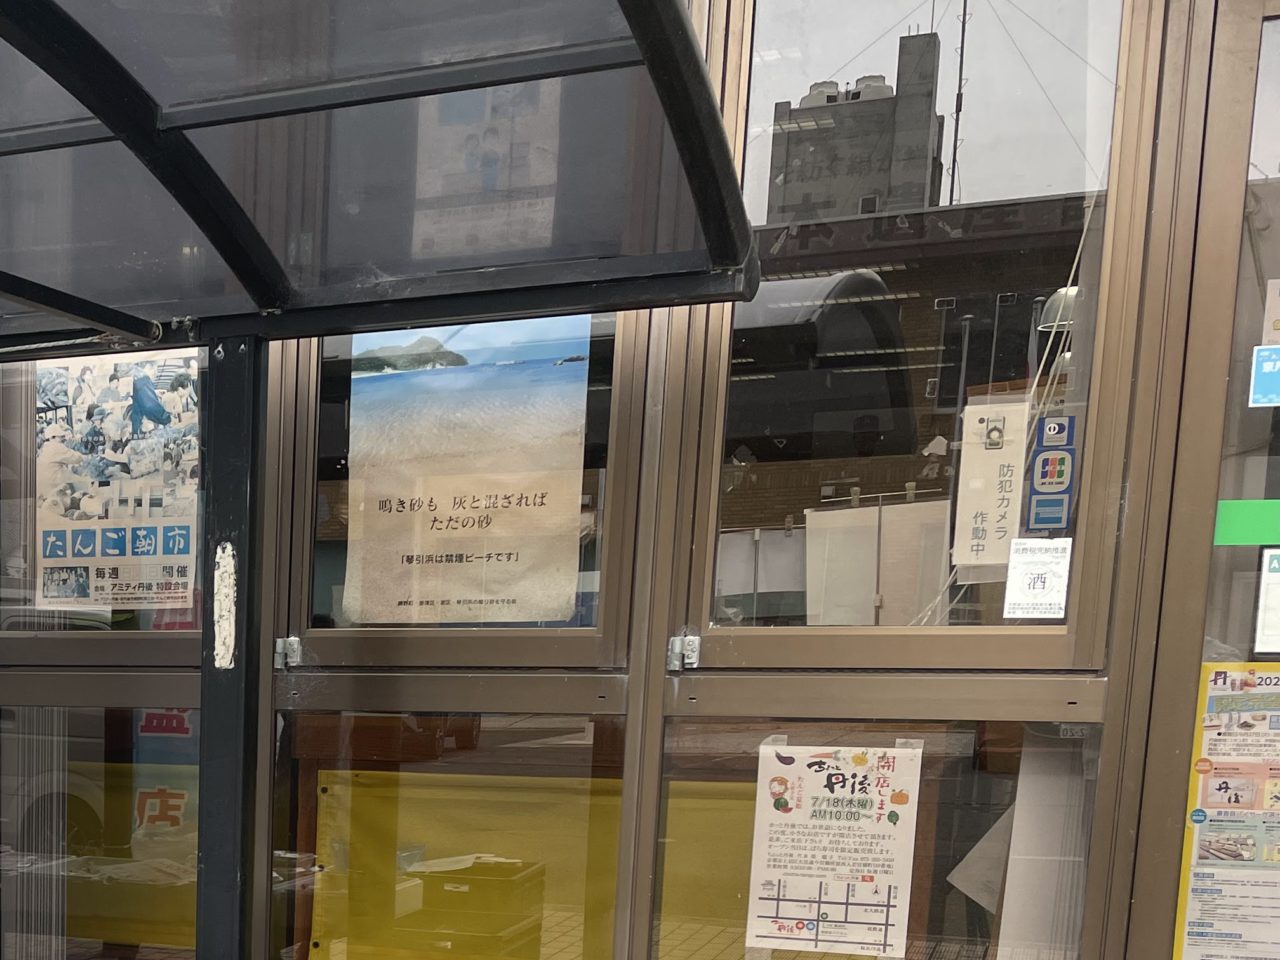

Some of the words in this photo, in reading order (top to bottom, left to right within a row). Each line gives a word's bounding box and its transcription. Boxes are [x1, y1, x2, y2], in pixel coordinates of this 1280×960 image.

[378, 497, 438, 513] 鳴き砂も
[452, 492, 549, 511] 灰と混ざれば
[995, 463, 1015, 540] 防犯カメラ
[430, 514, 492, 531] ただの砂
[46, 527, 187, 556] たんご朝市
[970, 511, 988, 557] 作動中
[401, 552, 519, 565] 「琴引浜は禁煙ビーチです」
[110, 582, 153, 592] アミティ丹後
[1028, 572, 1047, 590] 酒
[824, 772, 871, 795] 丹後
[874, 756, 896, 823] 開店します
